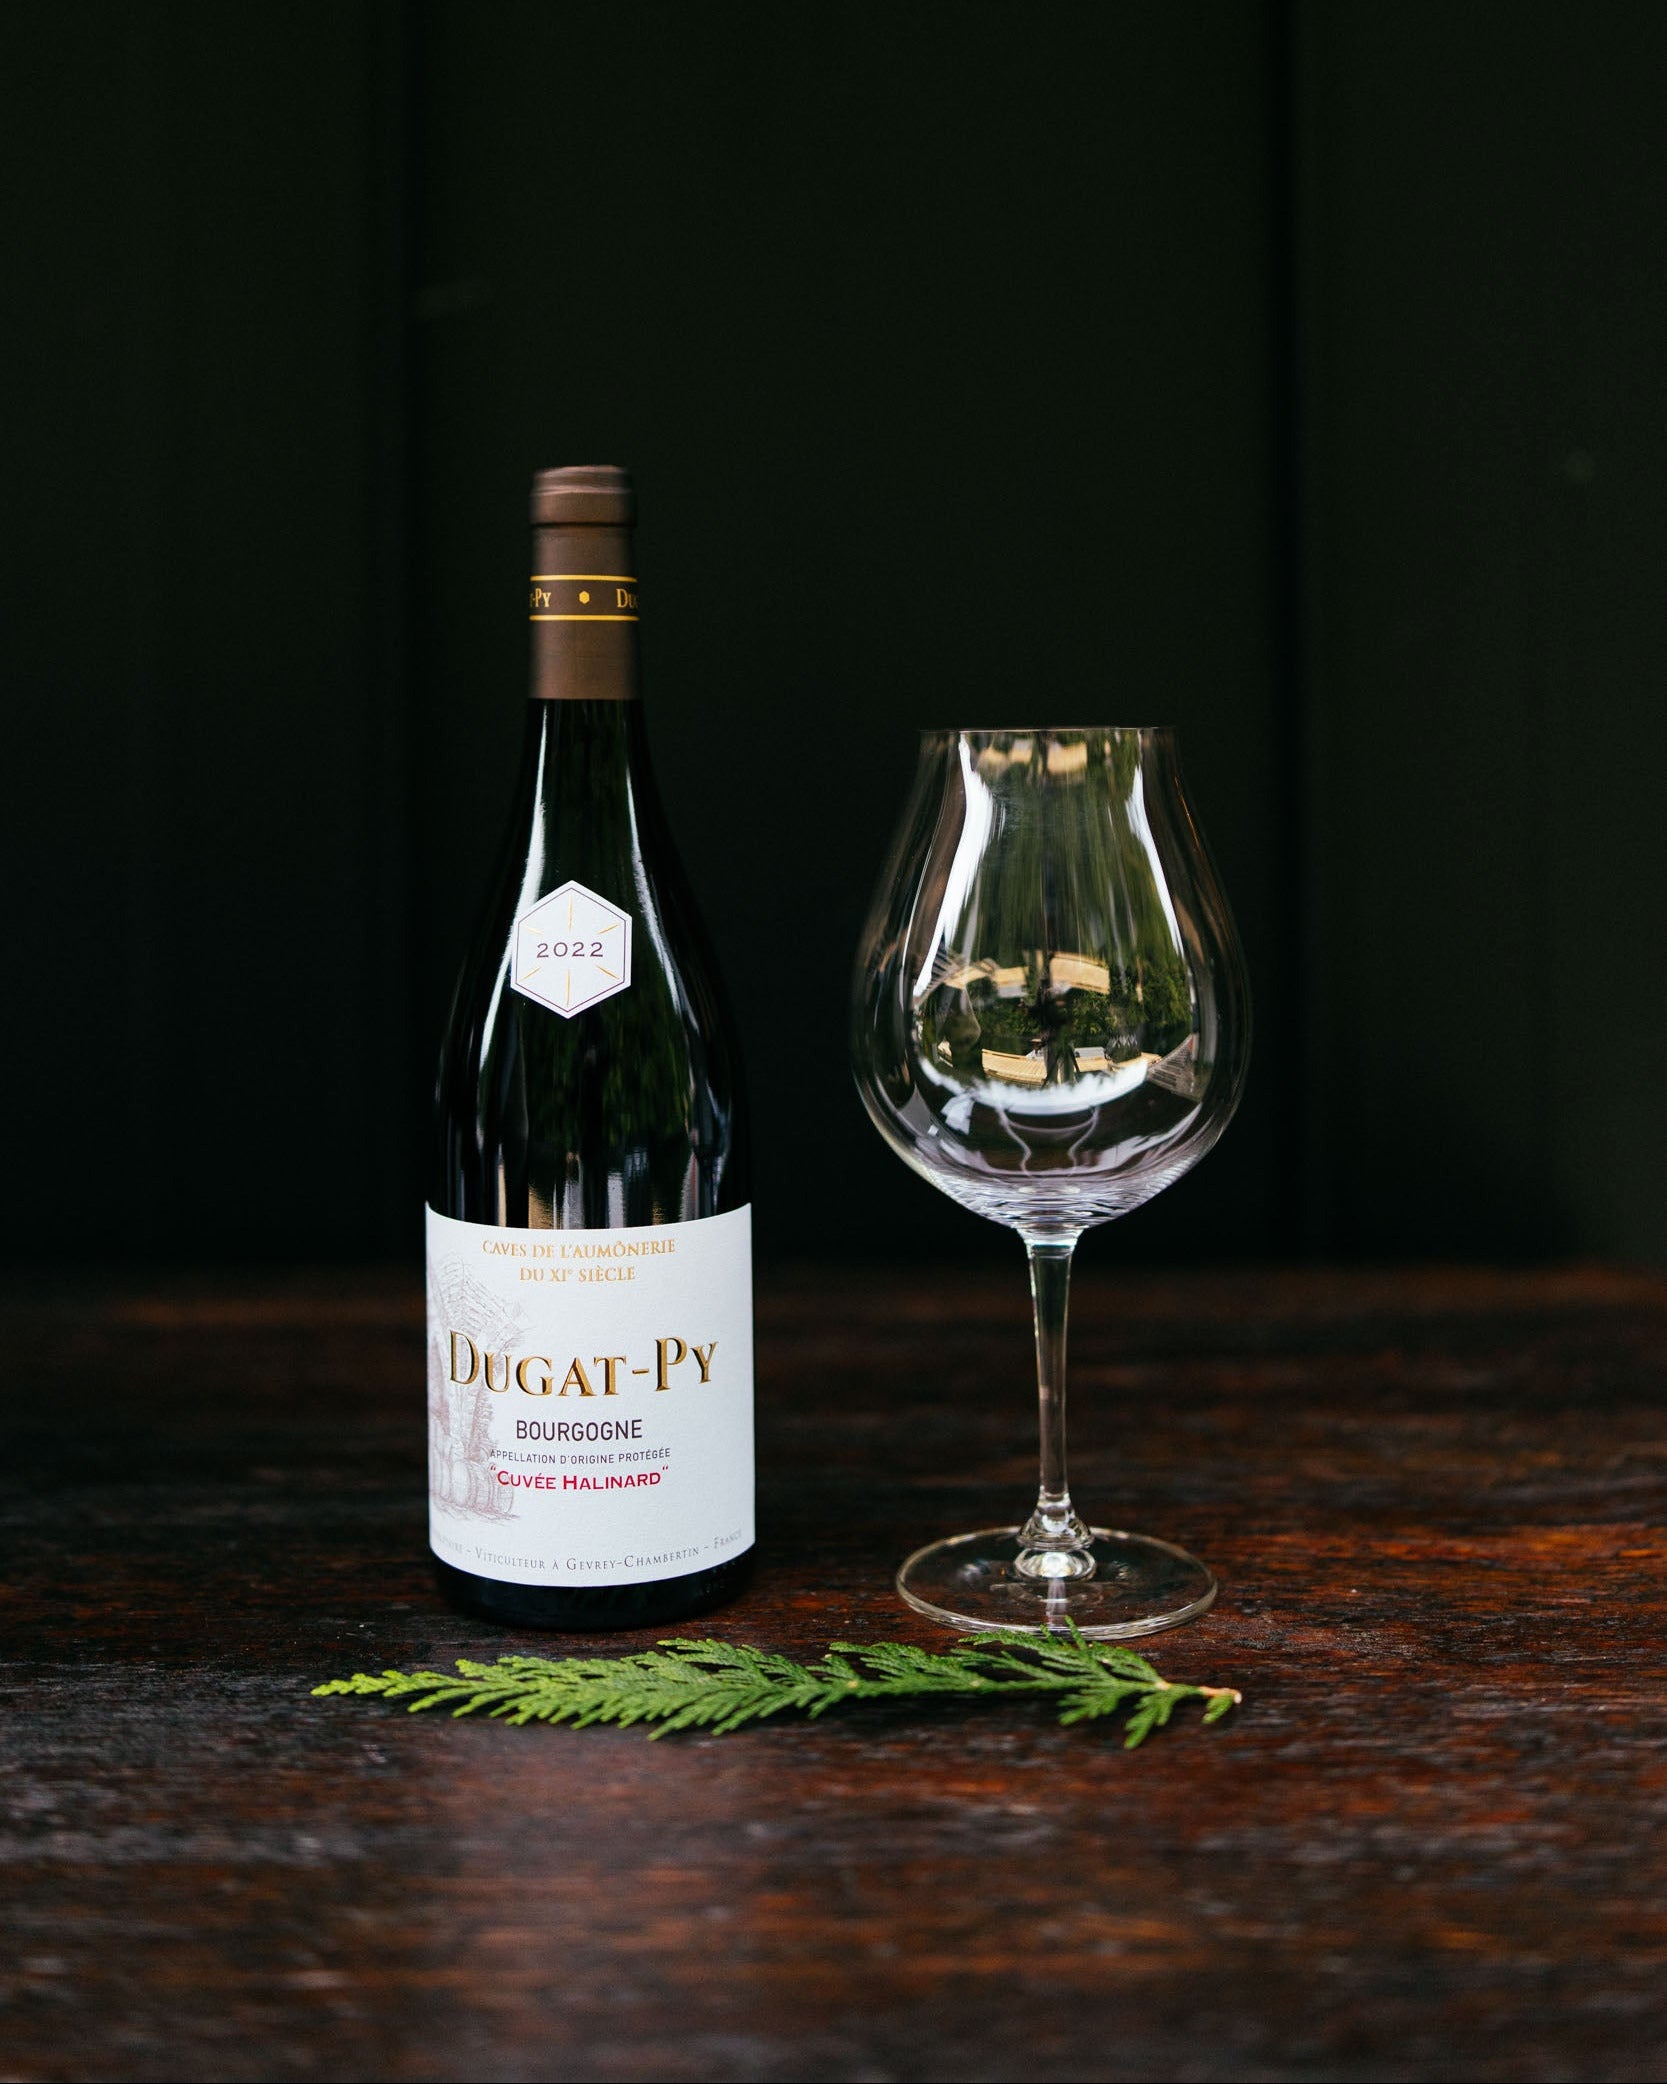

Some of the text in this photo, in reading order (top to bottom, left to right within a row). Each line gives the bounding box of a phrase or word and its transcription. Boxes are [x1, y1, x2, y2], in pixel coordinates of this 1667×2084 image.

[536, 942, 604, 958] 2022
[482, 1238, 676, 1259] CAVES DE L'AUMÔNERIE
[520, 1267, 544, 1281] DU
[578, 1265, 635, 1282] SIÈCLE
[516, 1419, 643, 1441] BOURGOGNE
[490, 1447, 671, 1465] APPELLATION D'ORIGINE PROTÉGÉE
[475, 1546, 545, 1570] VITICULTEUR
[566, 1546, 700, 1572] GEVREY-CHAMBERTIN
